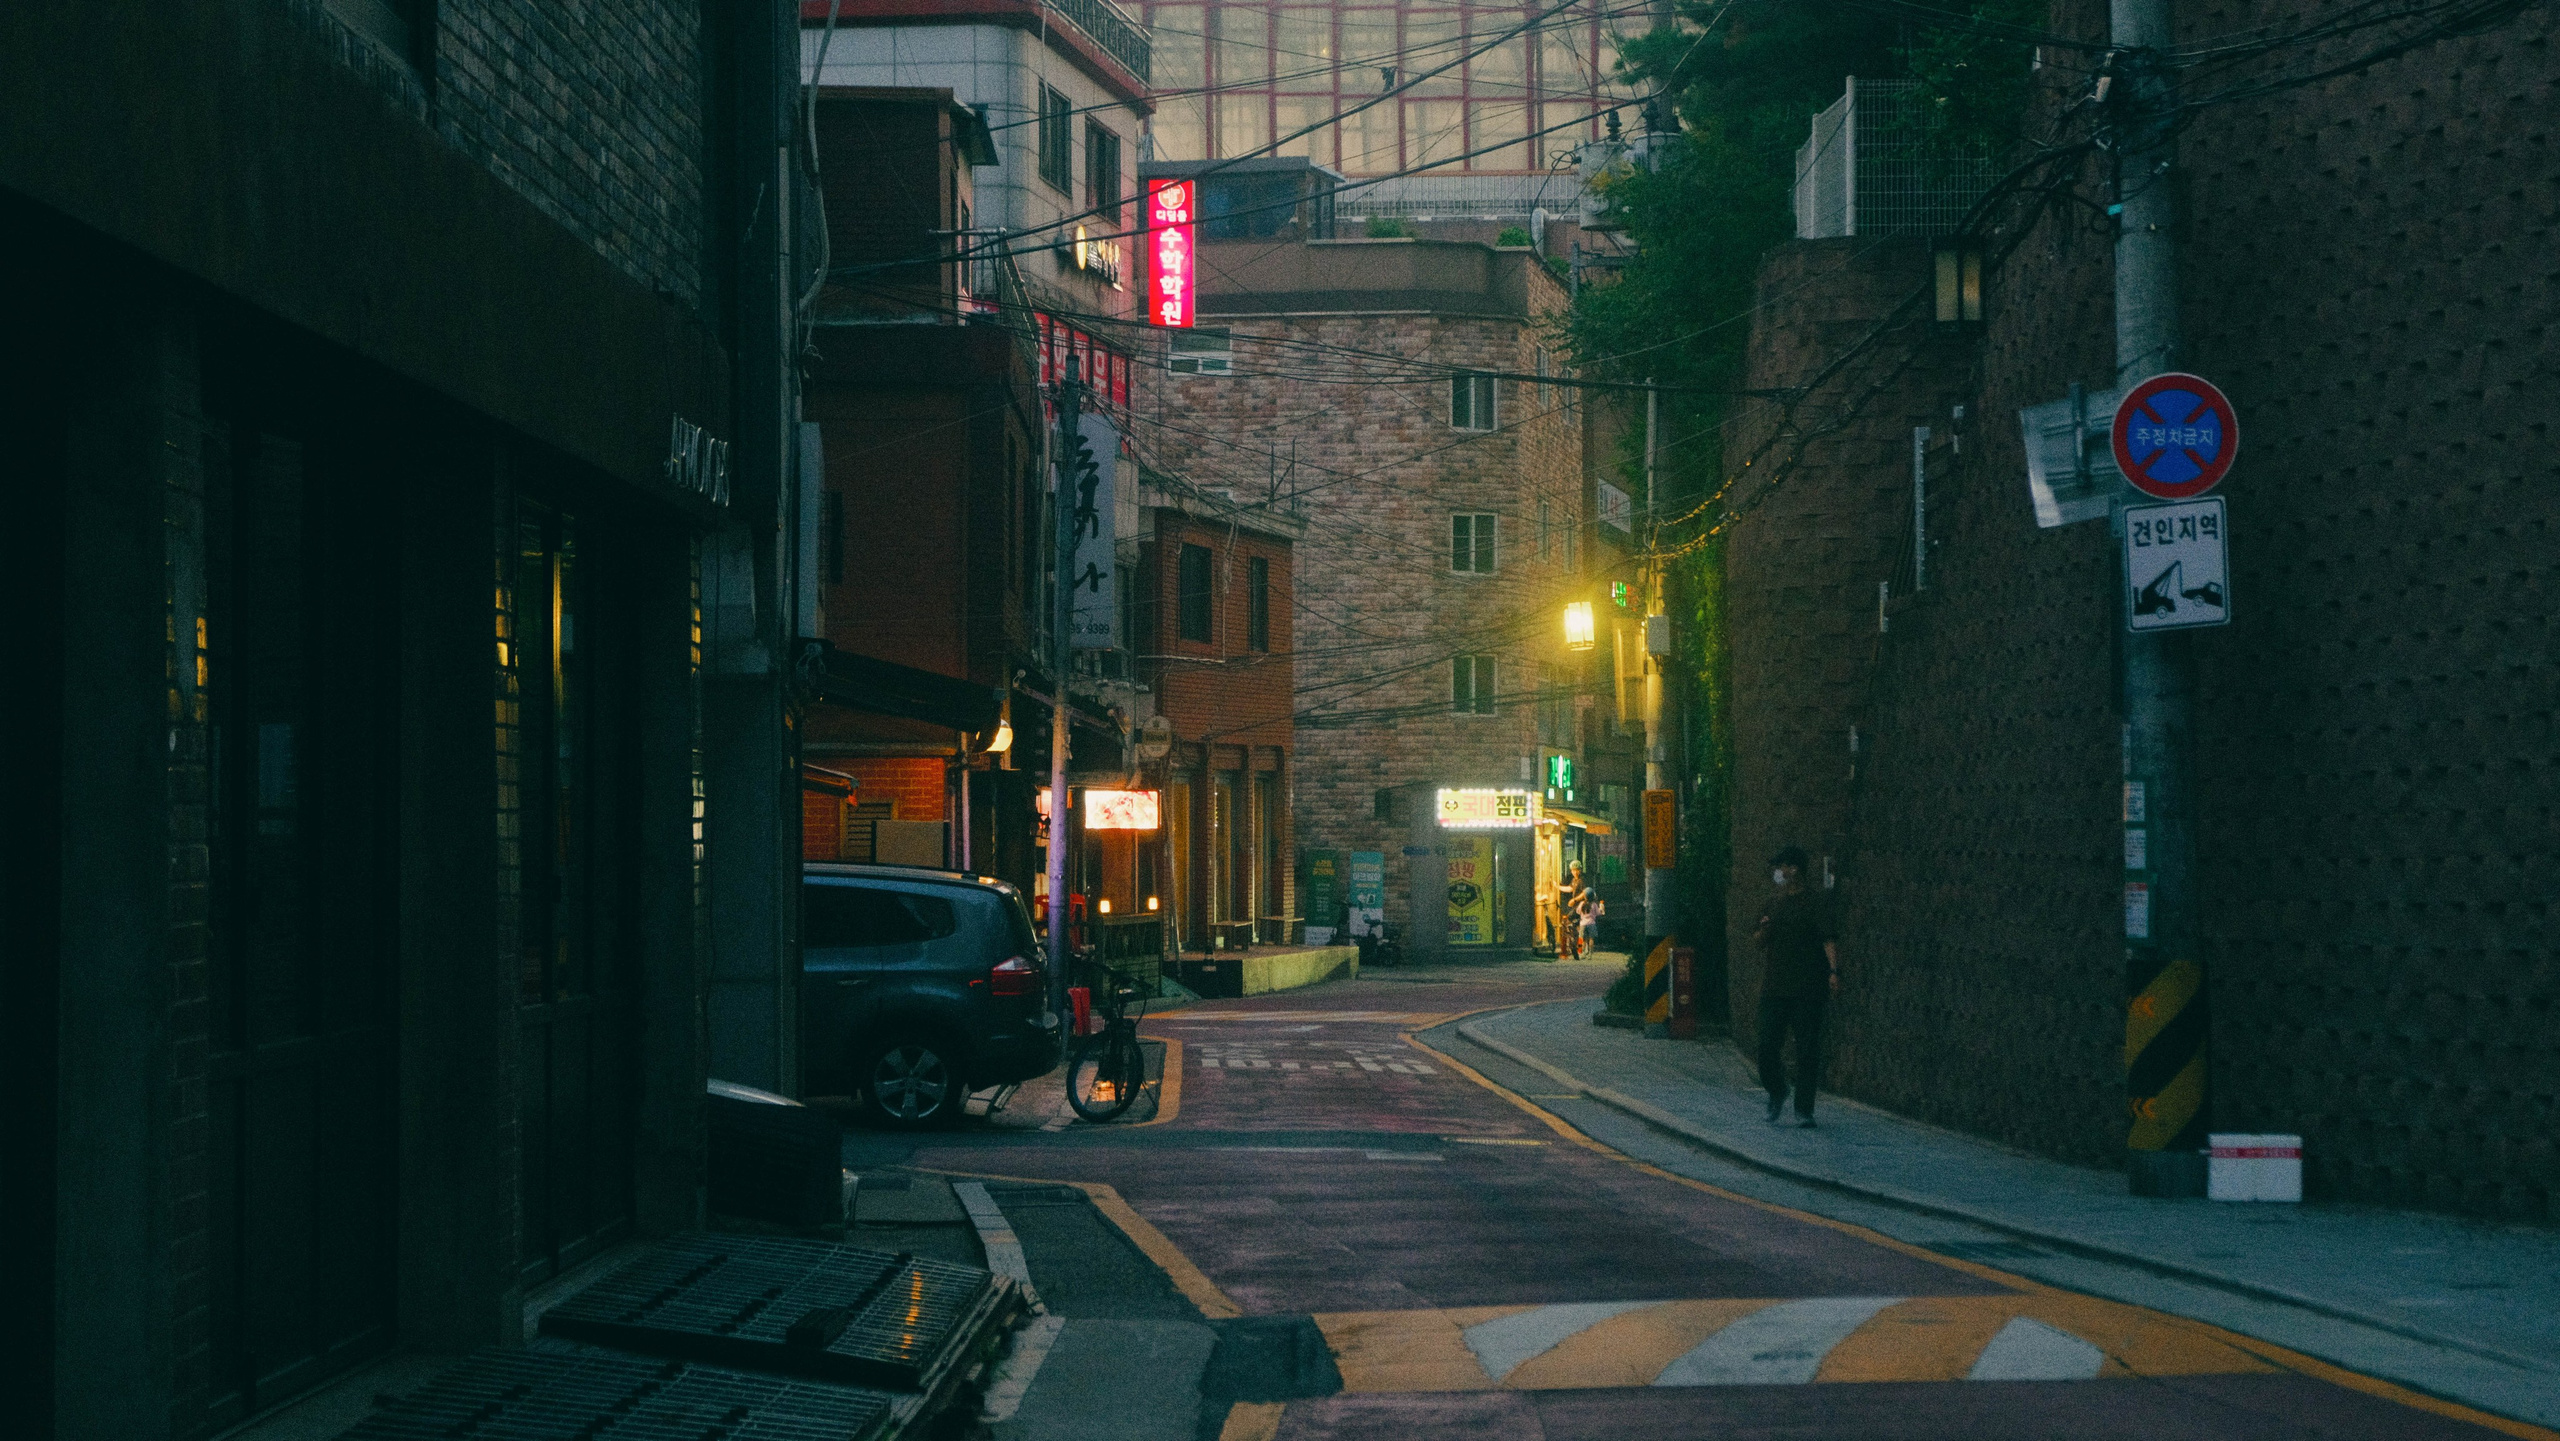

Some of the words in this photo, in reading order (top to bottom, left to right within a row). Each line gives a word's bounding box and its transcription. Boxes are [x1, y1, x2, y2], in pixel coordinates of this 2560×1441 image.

[1159, 227, 1184, 326] 수학학원
[2136, 428, 2215, 446] 주정차금지
[2133, 514, 2219, 547] 견인지역
[1462, 794, 1528, 817] 국대점핑
